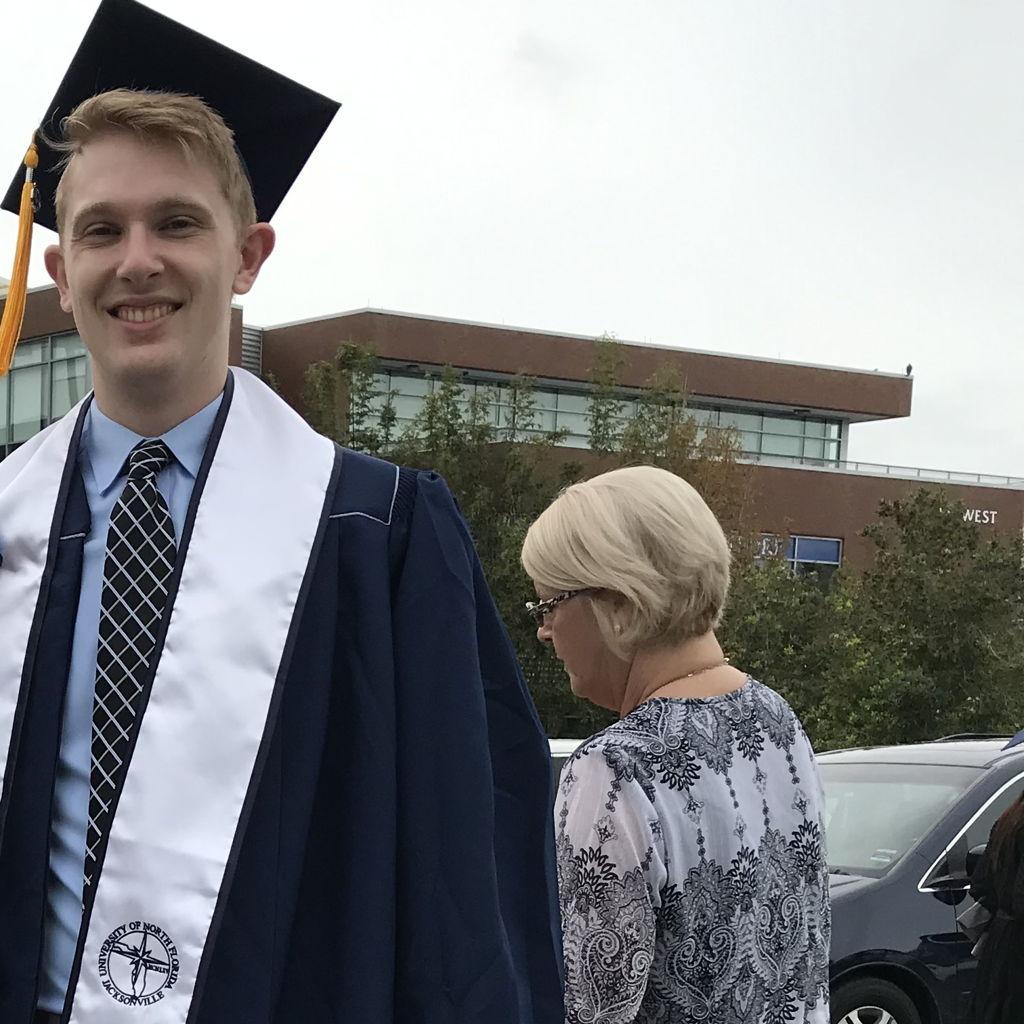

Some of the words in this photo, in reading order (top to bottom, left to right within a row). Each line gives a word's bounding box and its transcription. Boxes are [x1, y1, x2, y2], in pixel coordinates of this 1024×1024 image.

[963, 508, 997, 524] WEST
[98, 924, 127, 977] UNIVERSITY
[129, 921, 141, 930] OF
[143, 922, 172, 946] NORTH
[164, 946, 179, 990] FLORIDA
[102, 979, 165, 1007] JACKSONVILLE
